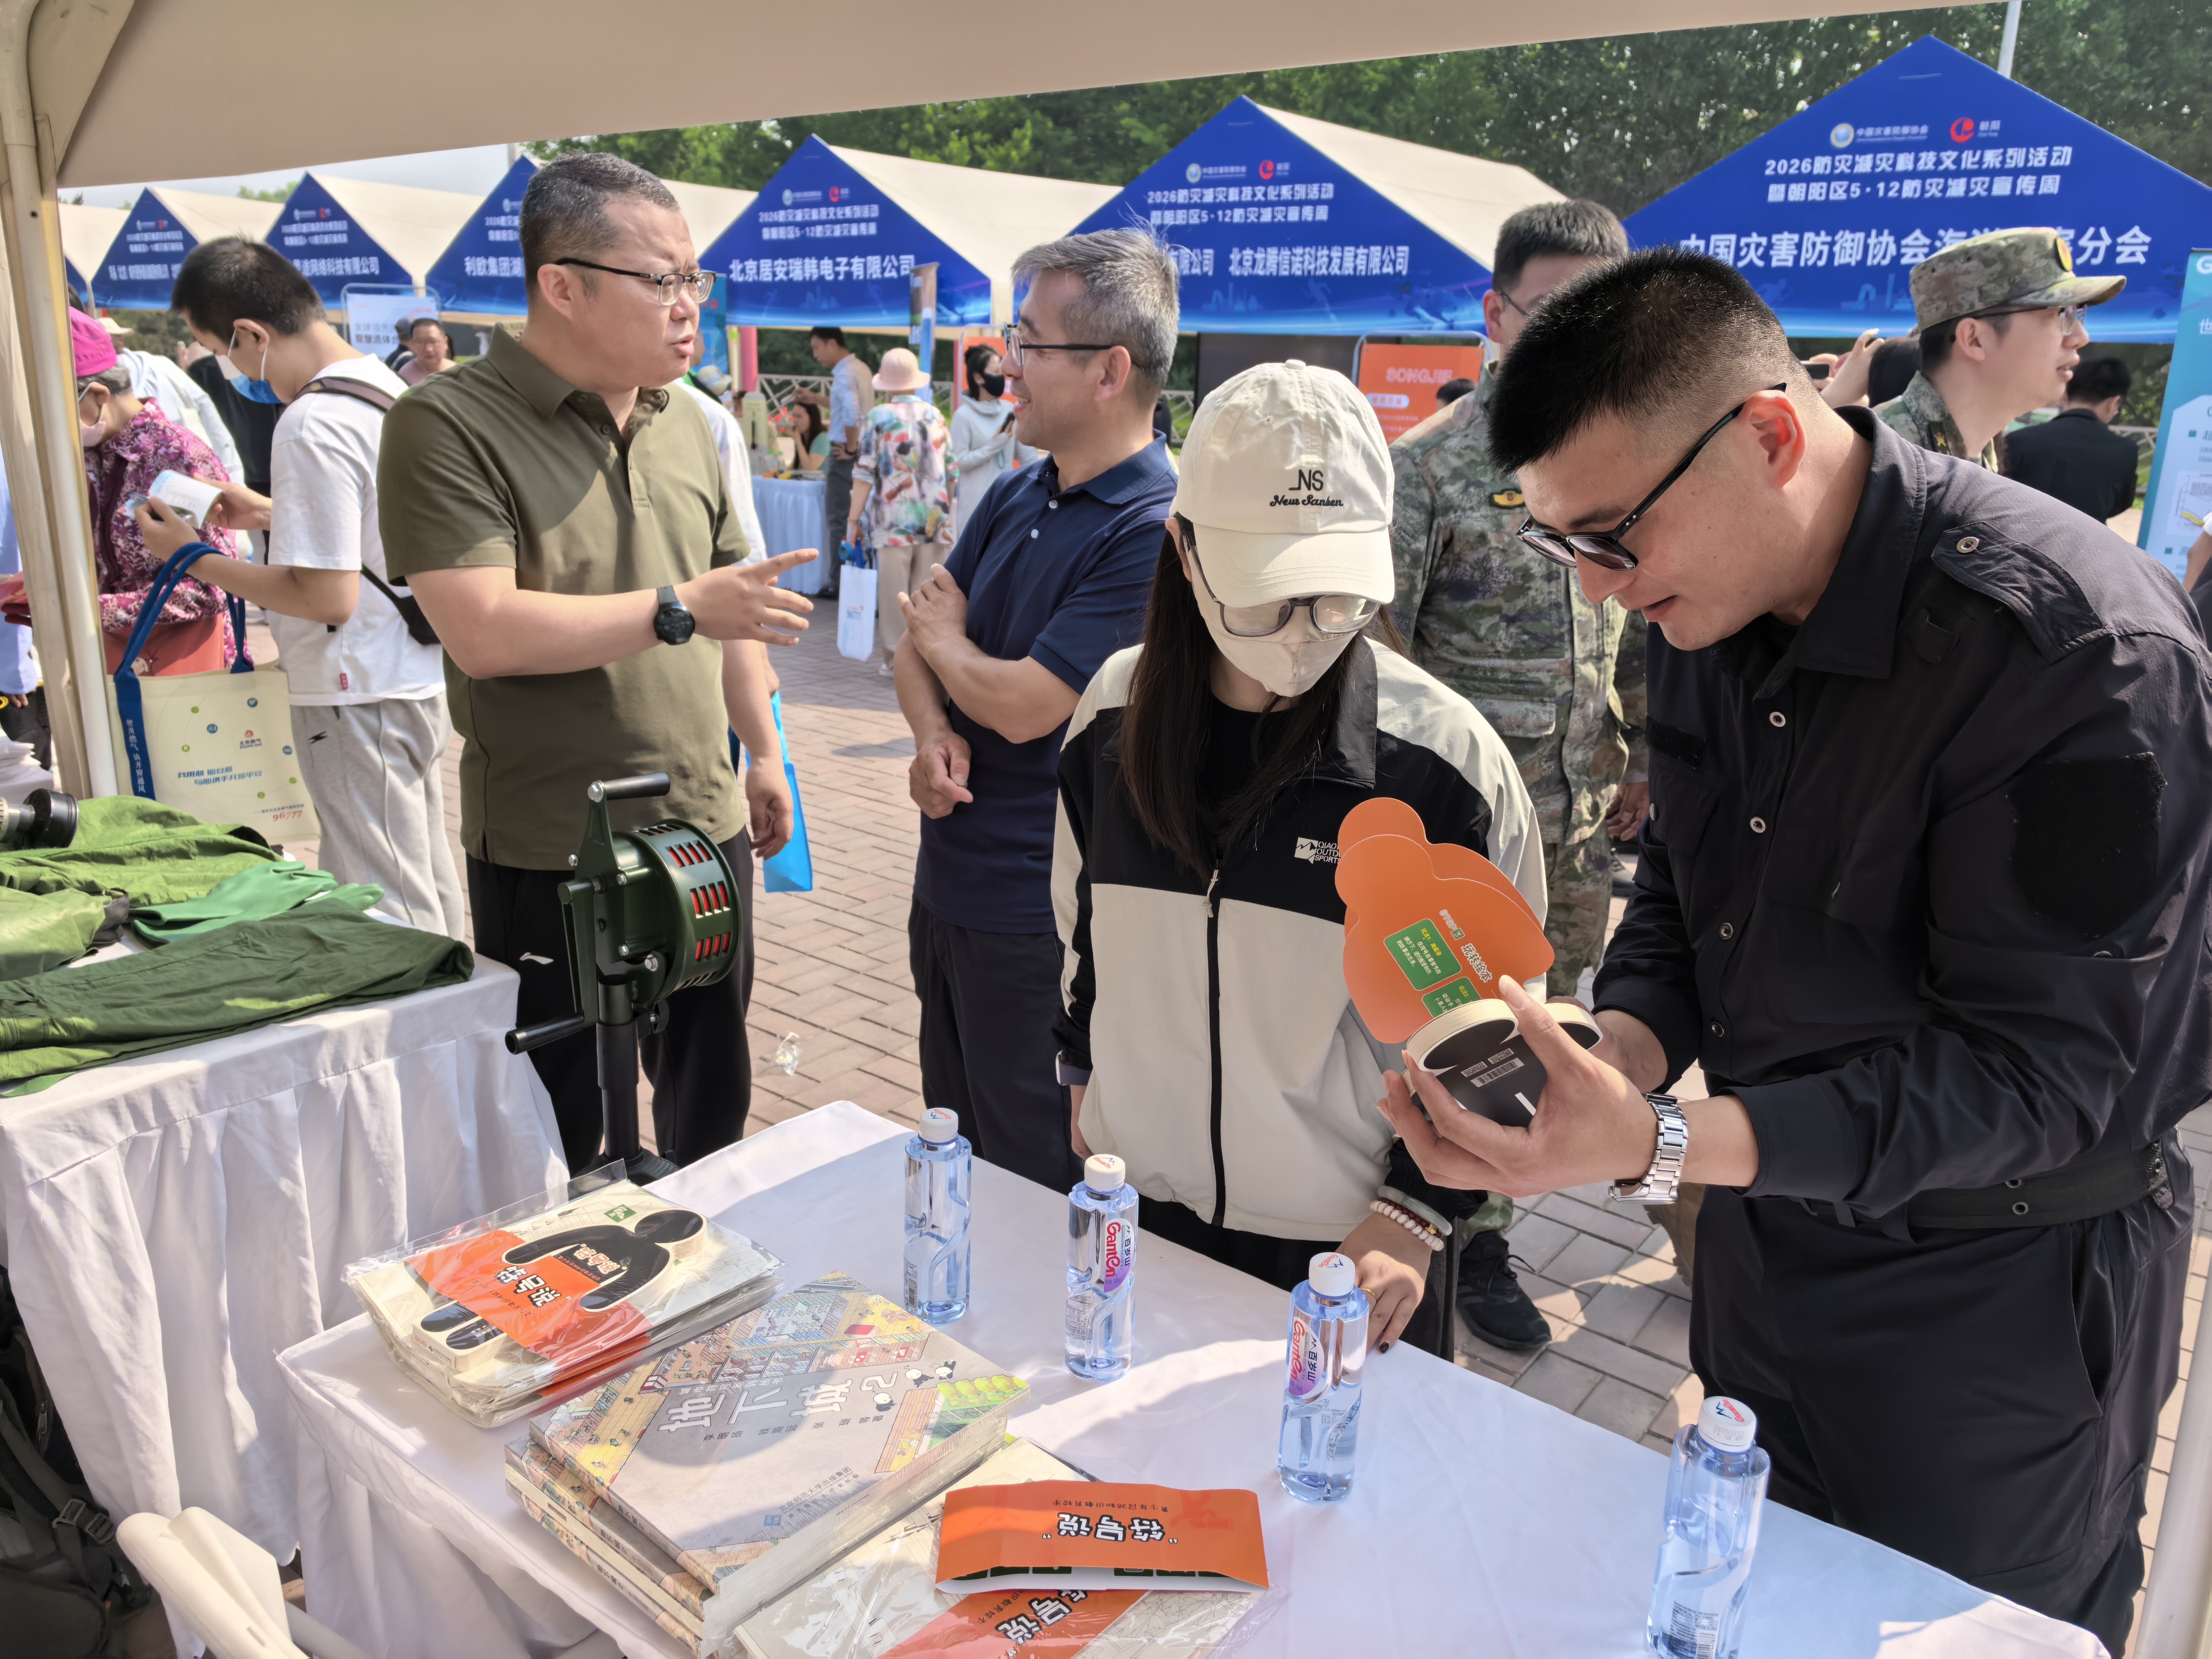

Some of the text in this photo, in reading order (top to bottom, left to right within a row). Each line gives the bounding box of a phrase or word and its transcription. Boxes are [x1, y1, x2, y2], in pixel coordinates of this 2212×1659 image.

[1764, 146, 2073, 176] 2026防灾减灾科技文化系列活动
[730, 254, 915, 282] 北京居安瑞韩电子有限公司
[1229, 246, 1410, 276] 北京龙腾信诺科技发展有限公司
[1270, 495, 1300, 507] New
[273, 810, 303, 822] 96777
[1315, 855, 1341, 864] SPORTS
[1318, 841, 1339, 850] QIAO
[1461, 943, 1492, 982] 玩转绘本
[1307, 1351, 1318, 1382] 百岁山
[779, 1467, 852, 1512] 北京师范大学出版集团
